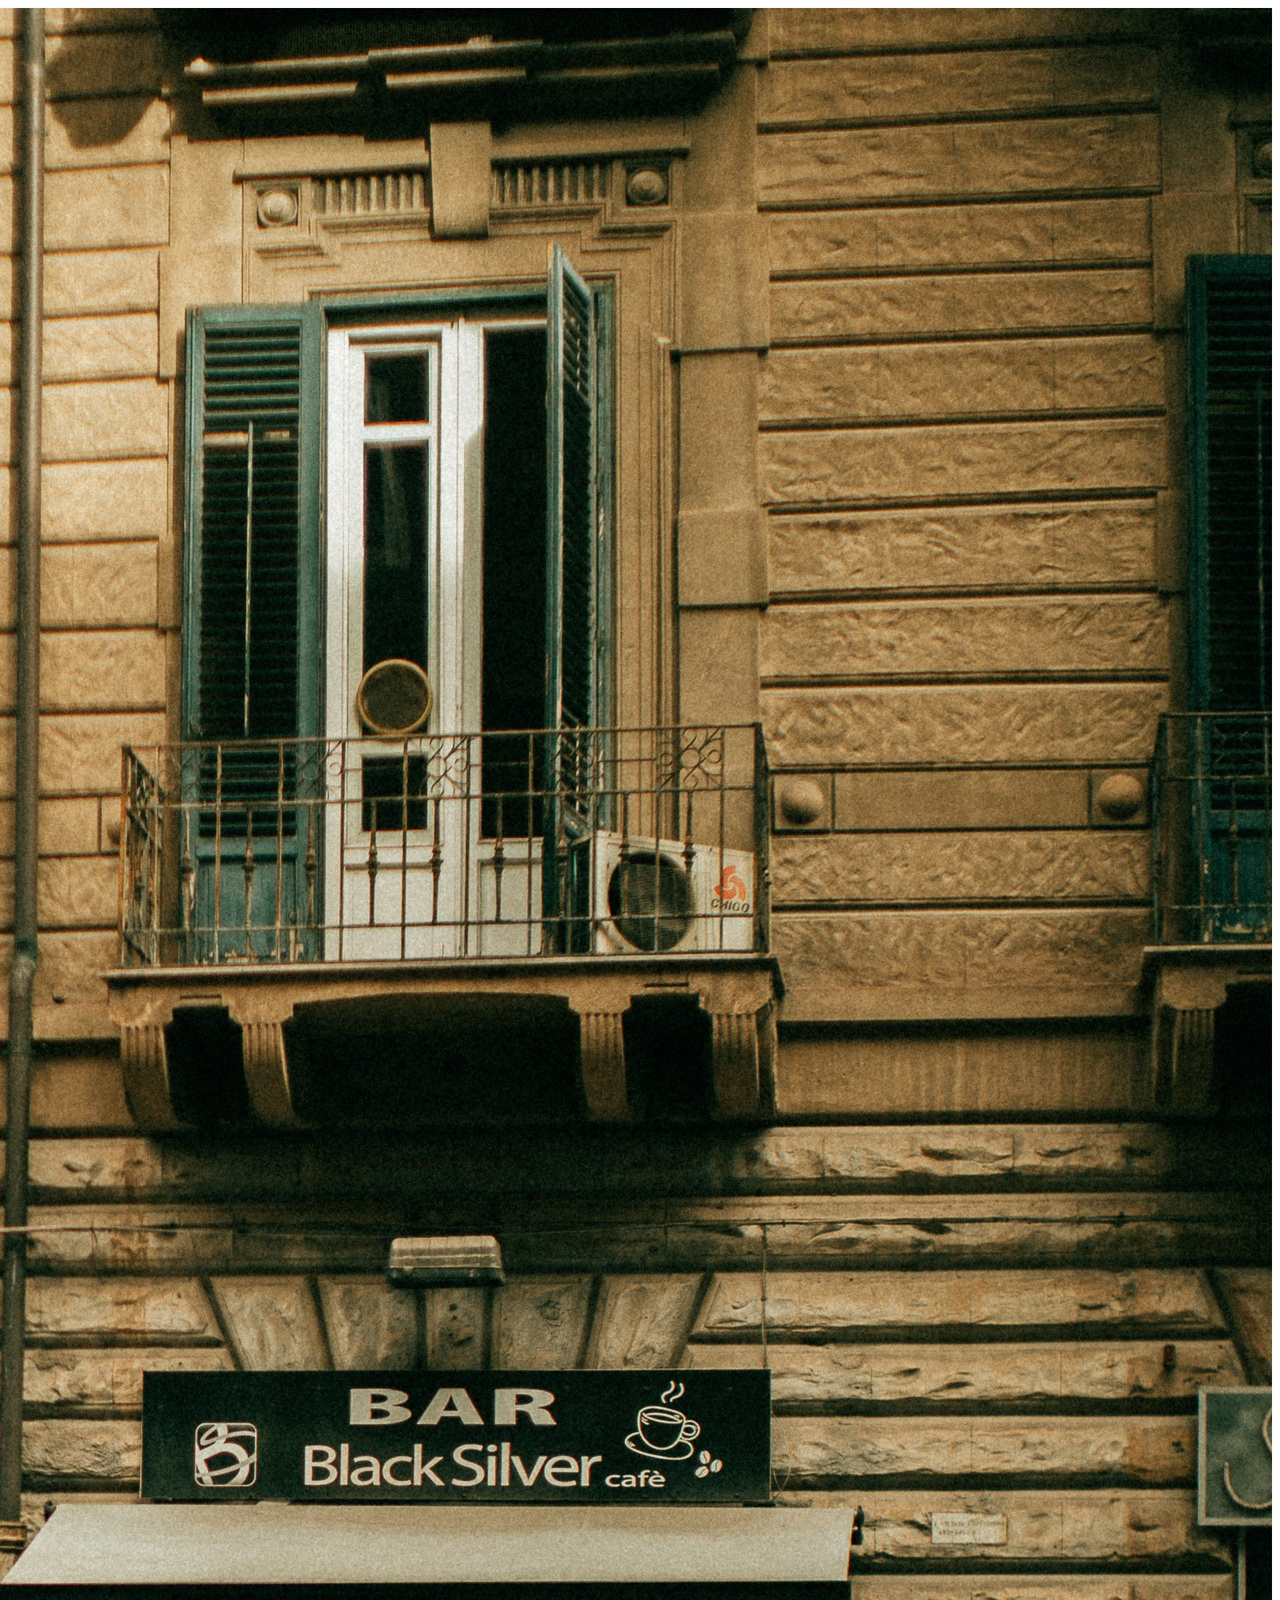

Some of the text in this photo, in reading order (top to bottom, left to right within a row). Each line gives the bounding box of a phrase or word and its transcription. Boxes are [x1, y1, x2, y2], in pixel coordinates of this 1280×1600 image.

[349, 1387, 557, 1425] BAR
[303, 1443, 667, 1488] Black Silver cafè
